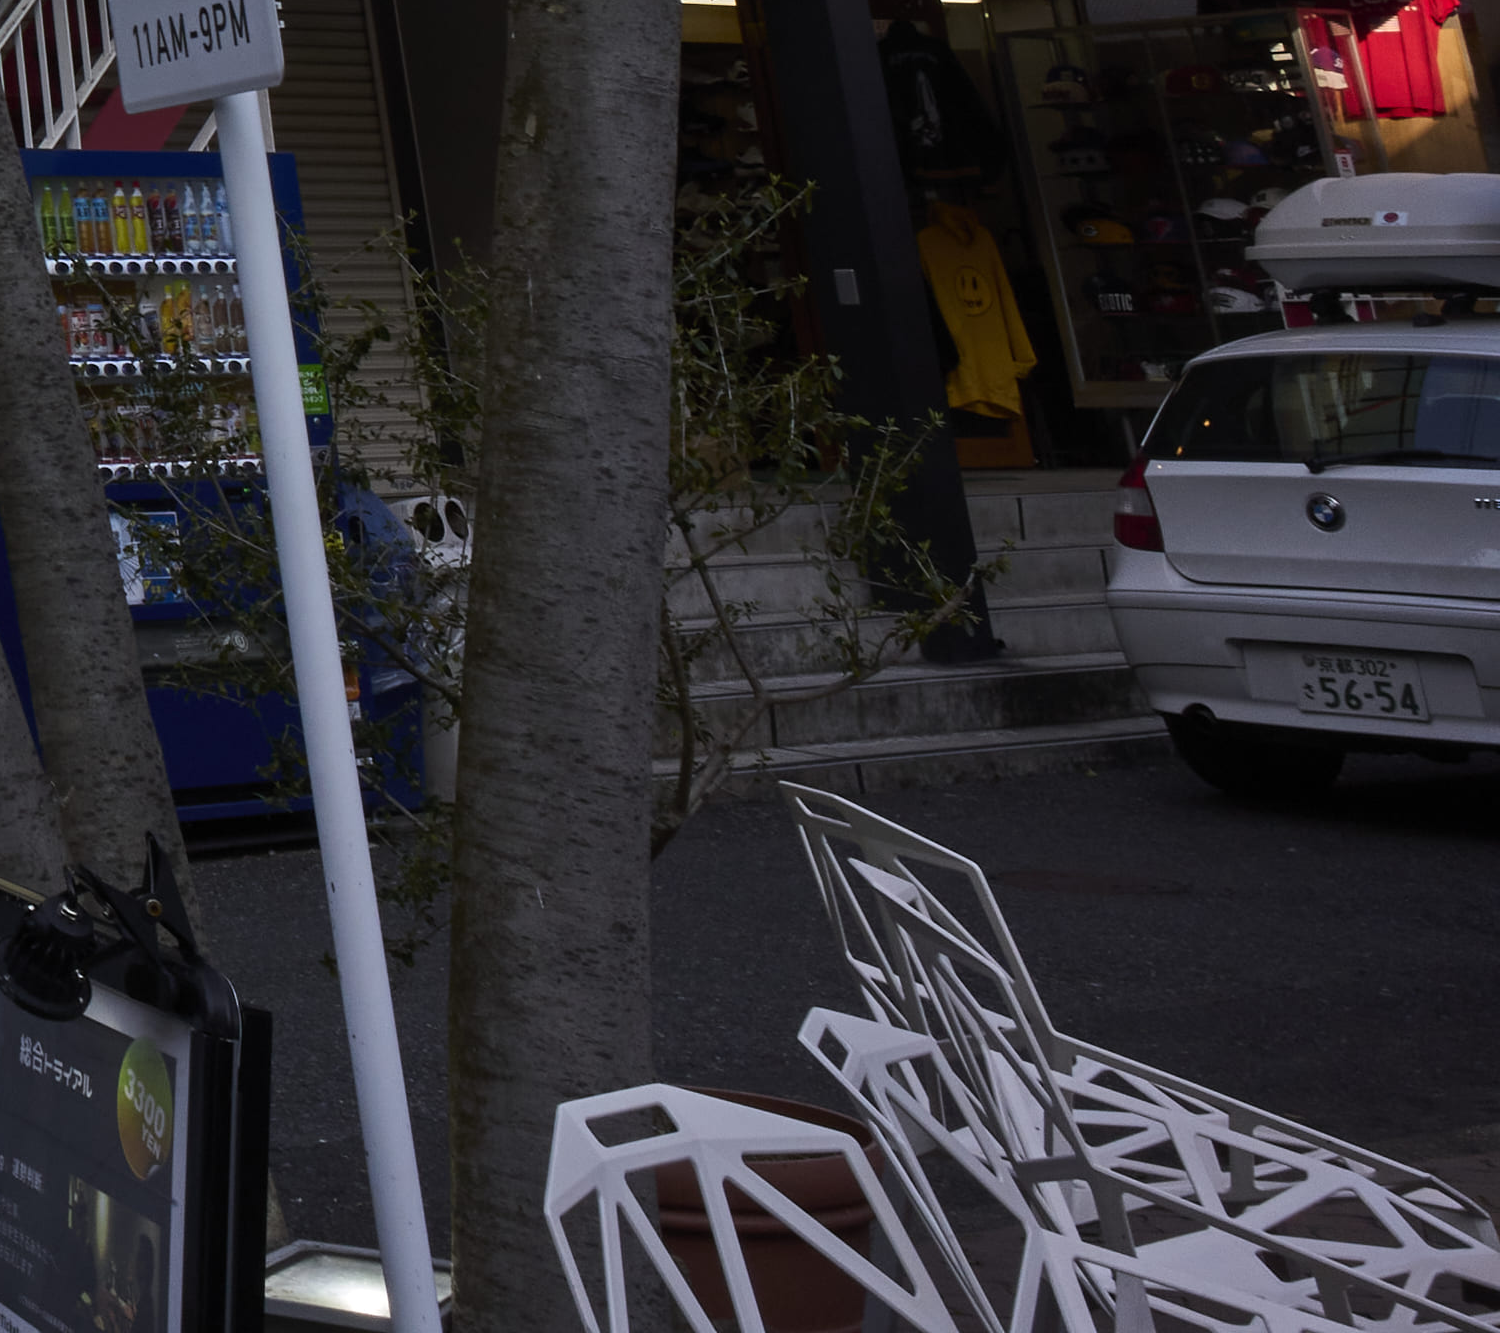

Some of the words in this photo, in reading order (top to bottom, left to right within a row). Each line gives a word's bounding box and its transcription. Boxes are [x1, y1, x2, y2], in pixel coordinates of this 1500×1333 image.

[1319, 676, 1420, 716] 56-54
[19, 1033, 93, 1099] 総合トライアル
[124, 1068, 167, 1139] 3300
[141, 1123, 162, 1160] YEN
